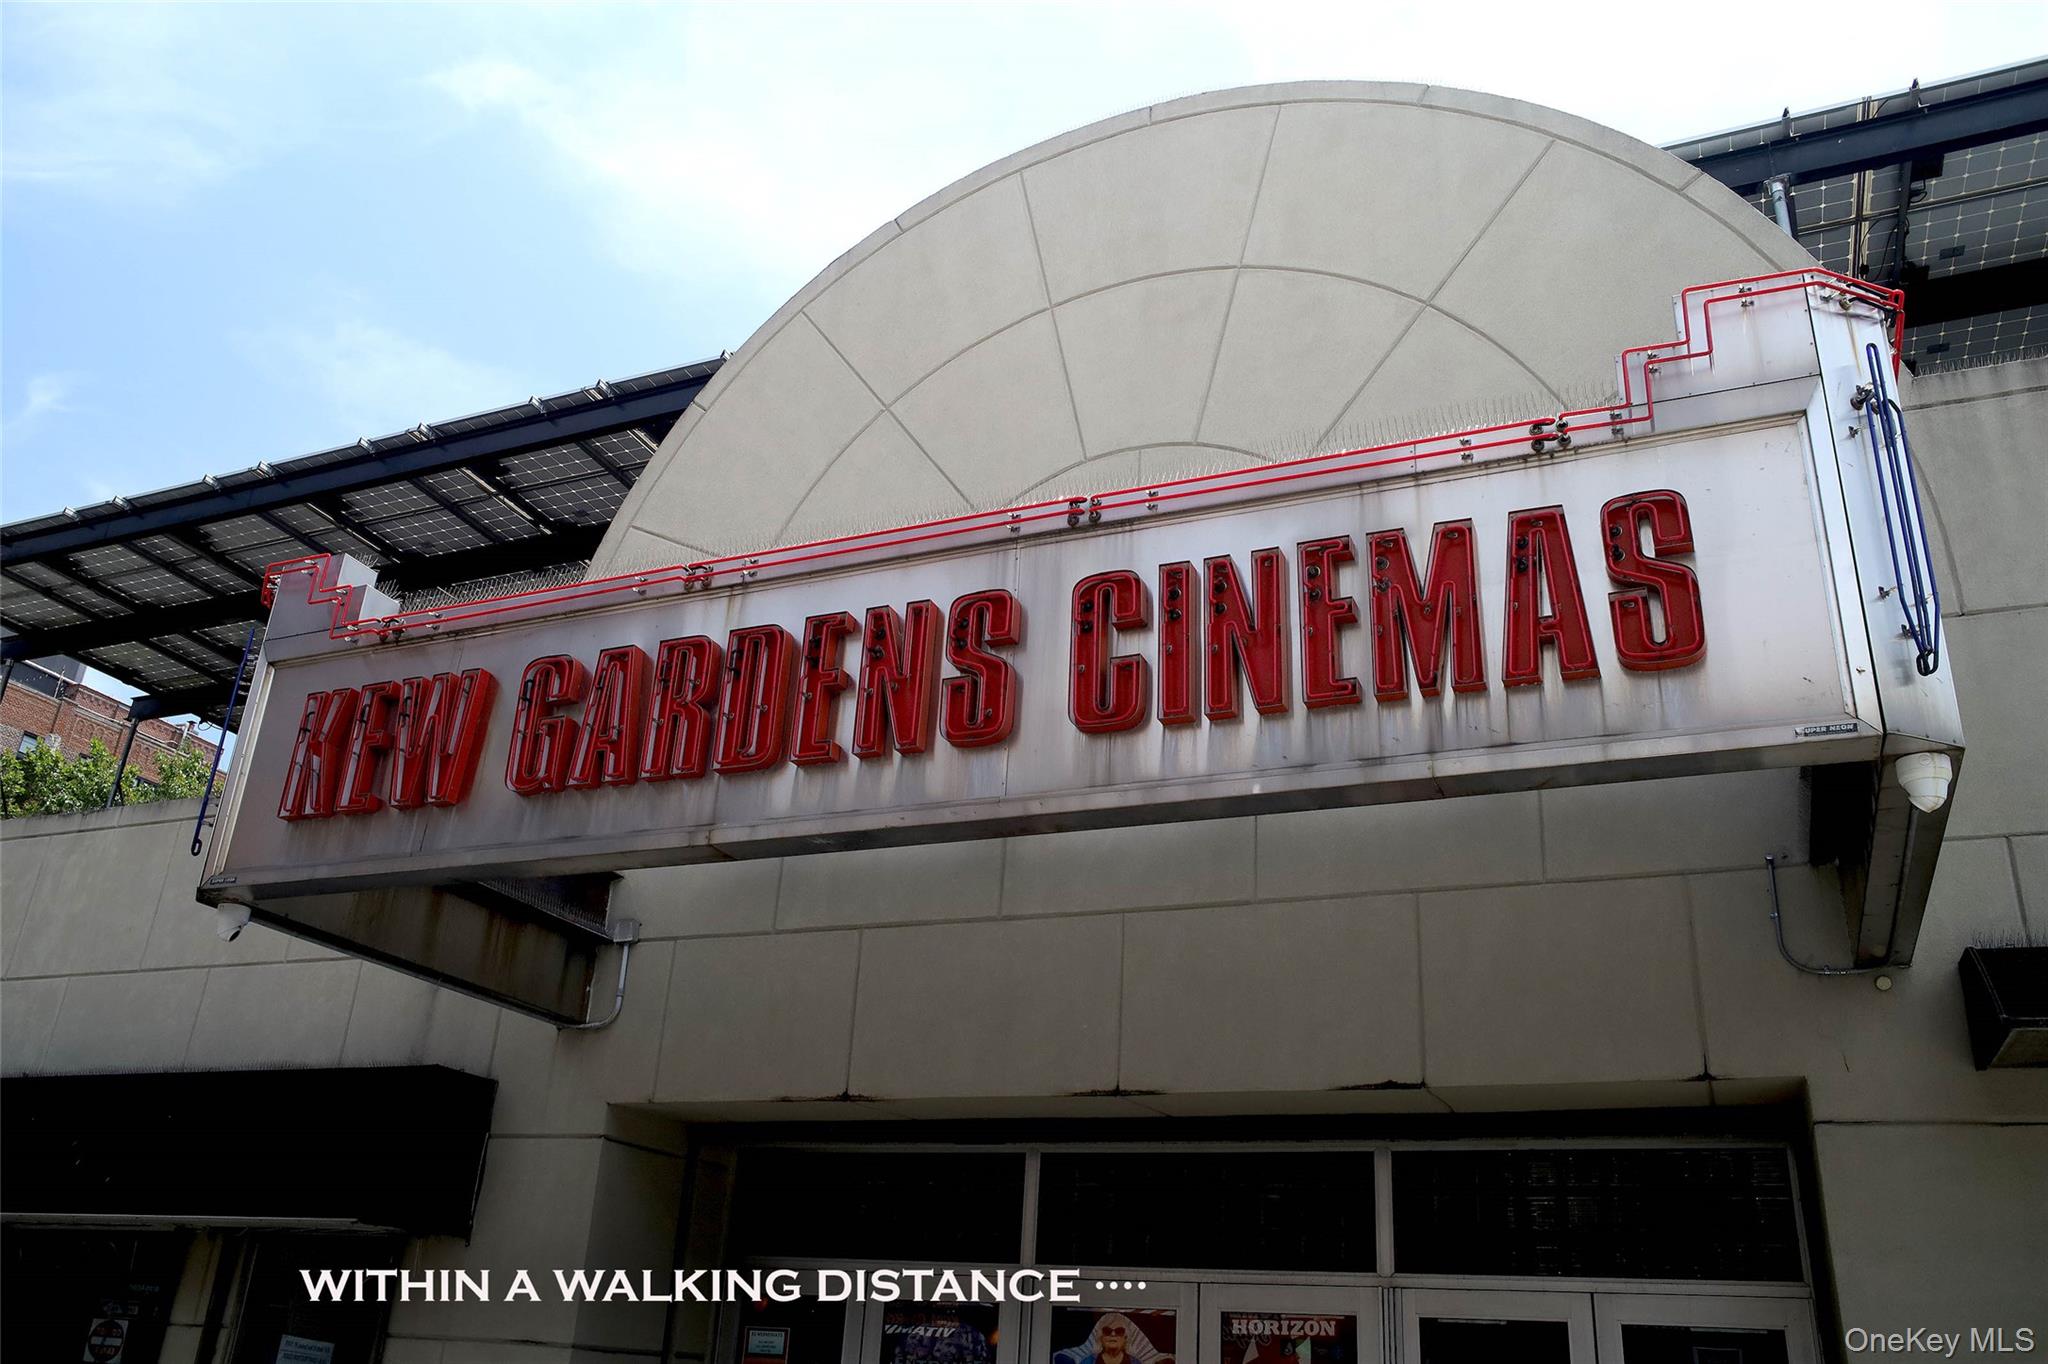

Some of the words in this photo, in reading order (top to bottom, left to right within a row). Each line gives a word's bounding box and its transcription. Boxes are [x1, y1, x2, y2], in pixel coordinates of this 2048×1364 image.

[280, 667, 500, 821] KEW
[505, 588, 1022, 797] GARDENS
[1069, 489, 1707, 735] CINEMAS
[1829, 723, 1854, 731] NEON
[1231, 1319, 1336, 1336] HORIZON
